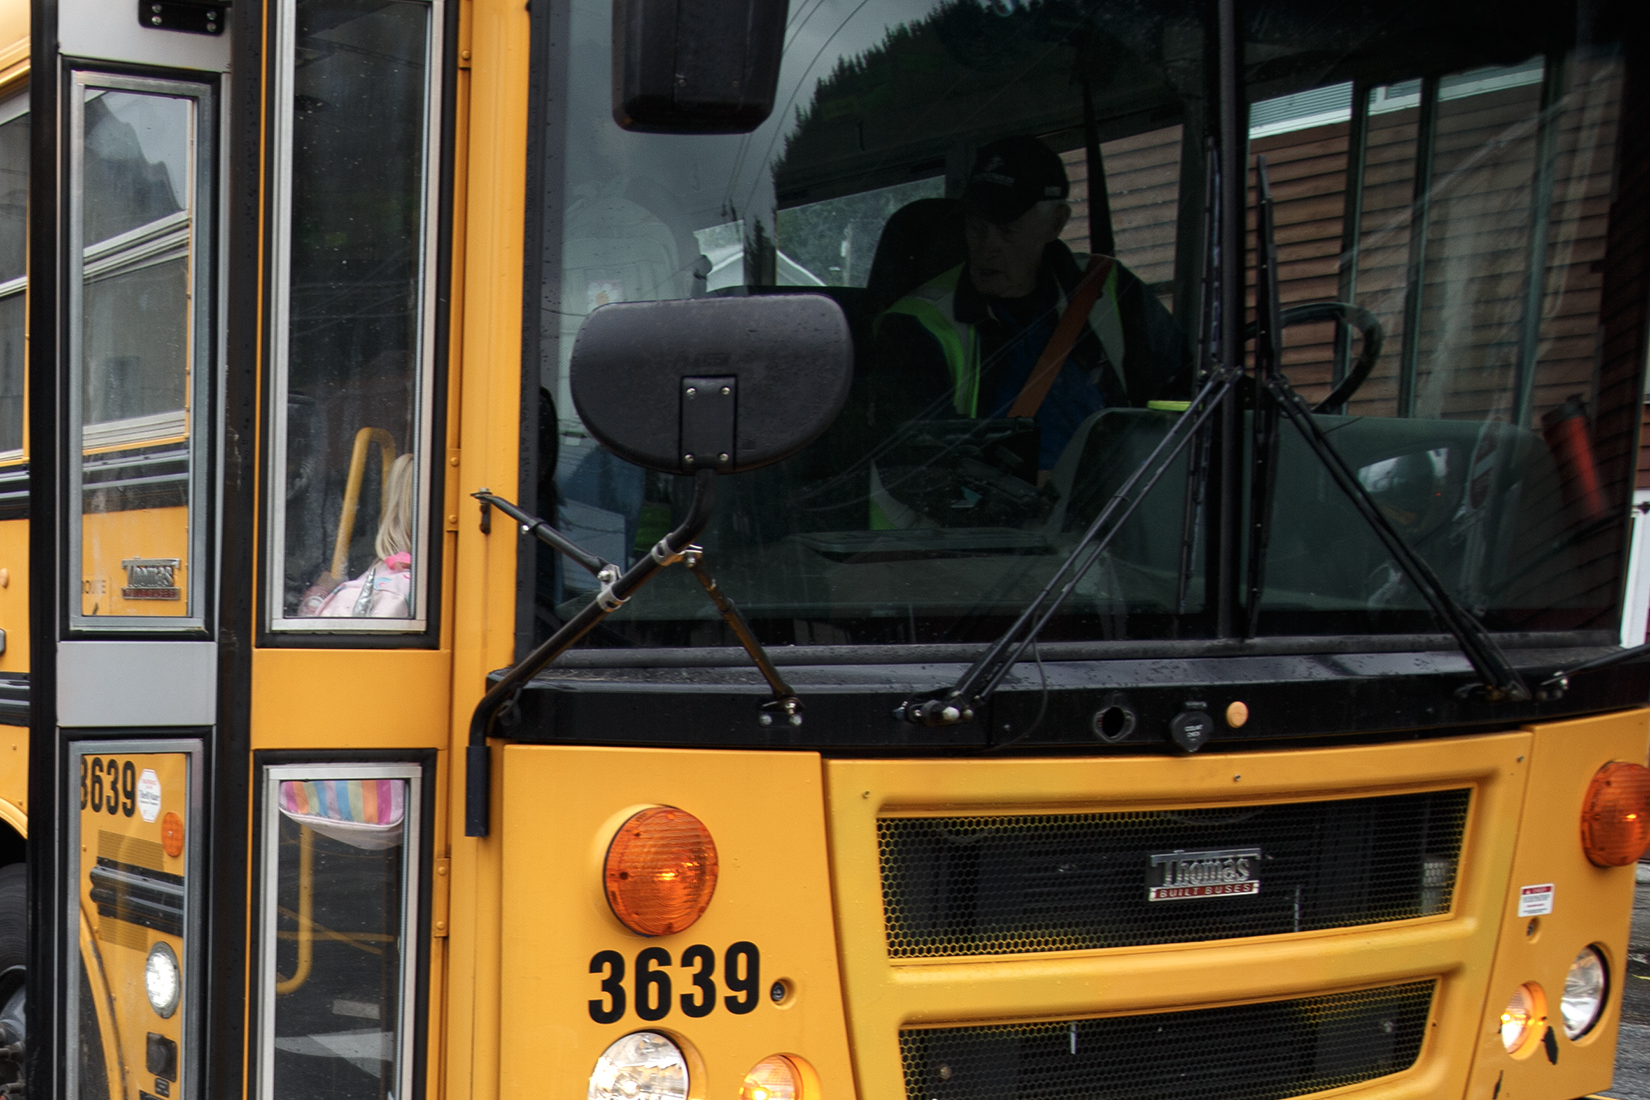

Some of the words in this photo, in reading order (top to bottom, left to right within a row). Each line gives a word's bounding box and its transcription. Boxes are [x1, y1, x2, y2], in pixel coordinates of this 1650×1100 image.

[1151, 848, 1261, 887] Thomas
[1159, 887, 1199, 899] BUILT
[1205, 883, 1251, 895] BUSES
[588, 941, 760, 1024] 3639
